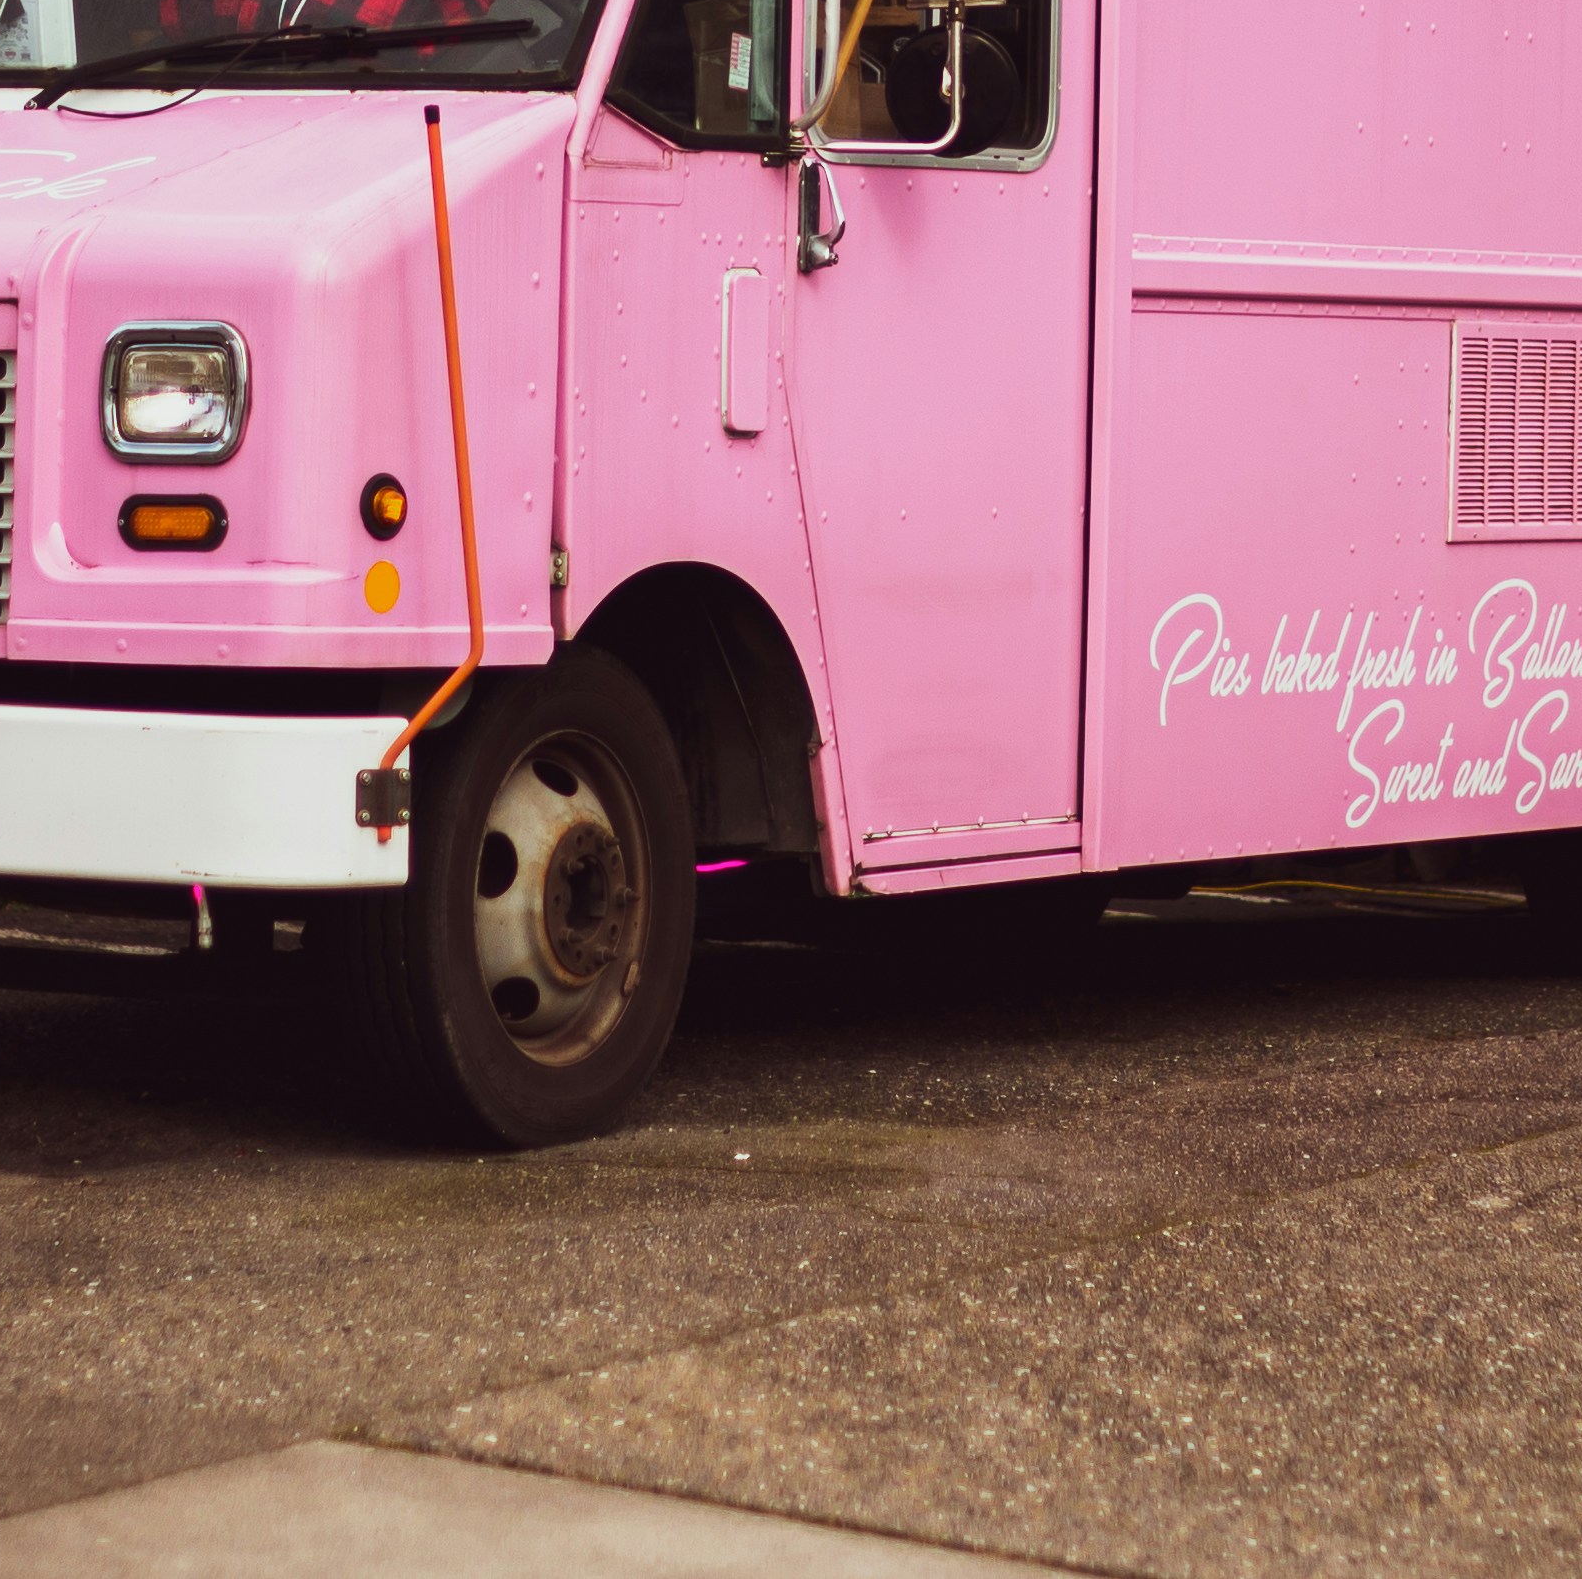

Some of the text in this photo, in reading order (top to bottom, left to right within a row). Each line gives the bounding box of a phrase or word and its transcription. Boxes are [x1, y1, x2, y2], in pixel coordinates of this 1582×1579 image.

[1149, 592, 1252, 727] Pies
[1261, 608, 1353, 696] baked
[1336, 605, 1423, 733] fresh
[1425, 628, 1458, 686] in
[1344, 698, 1455, 830] Sweet
[1452, 720, 1520, 798] and
